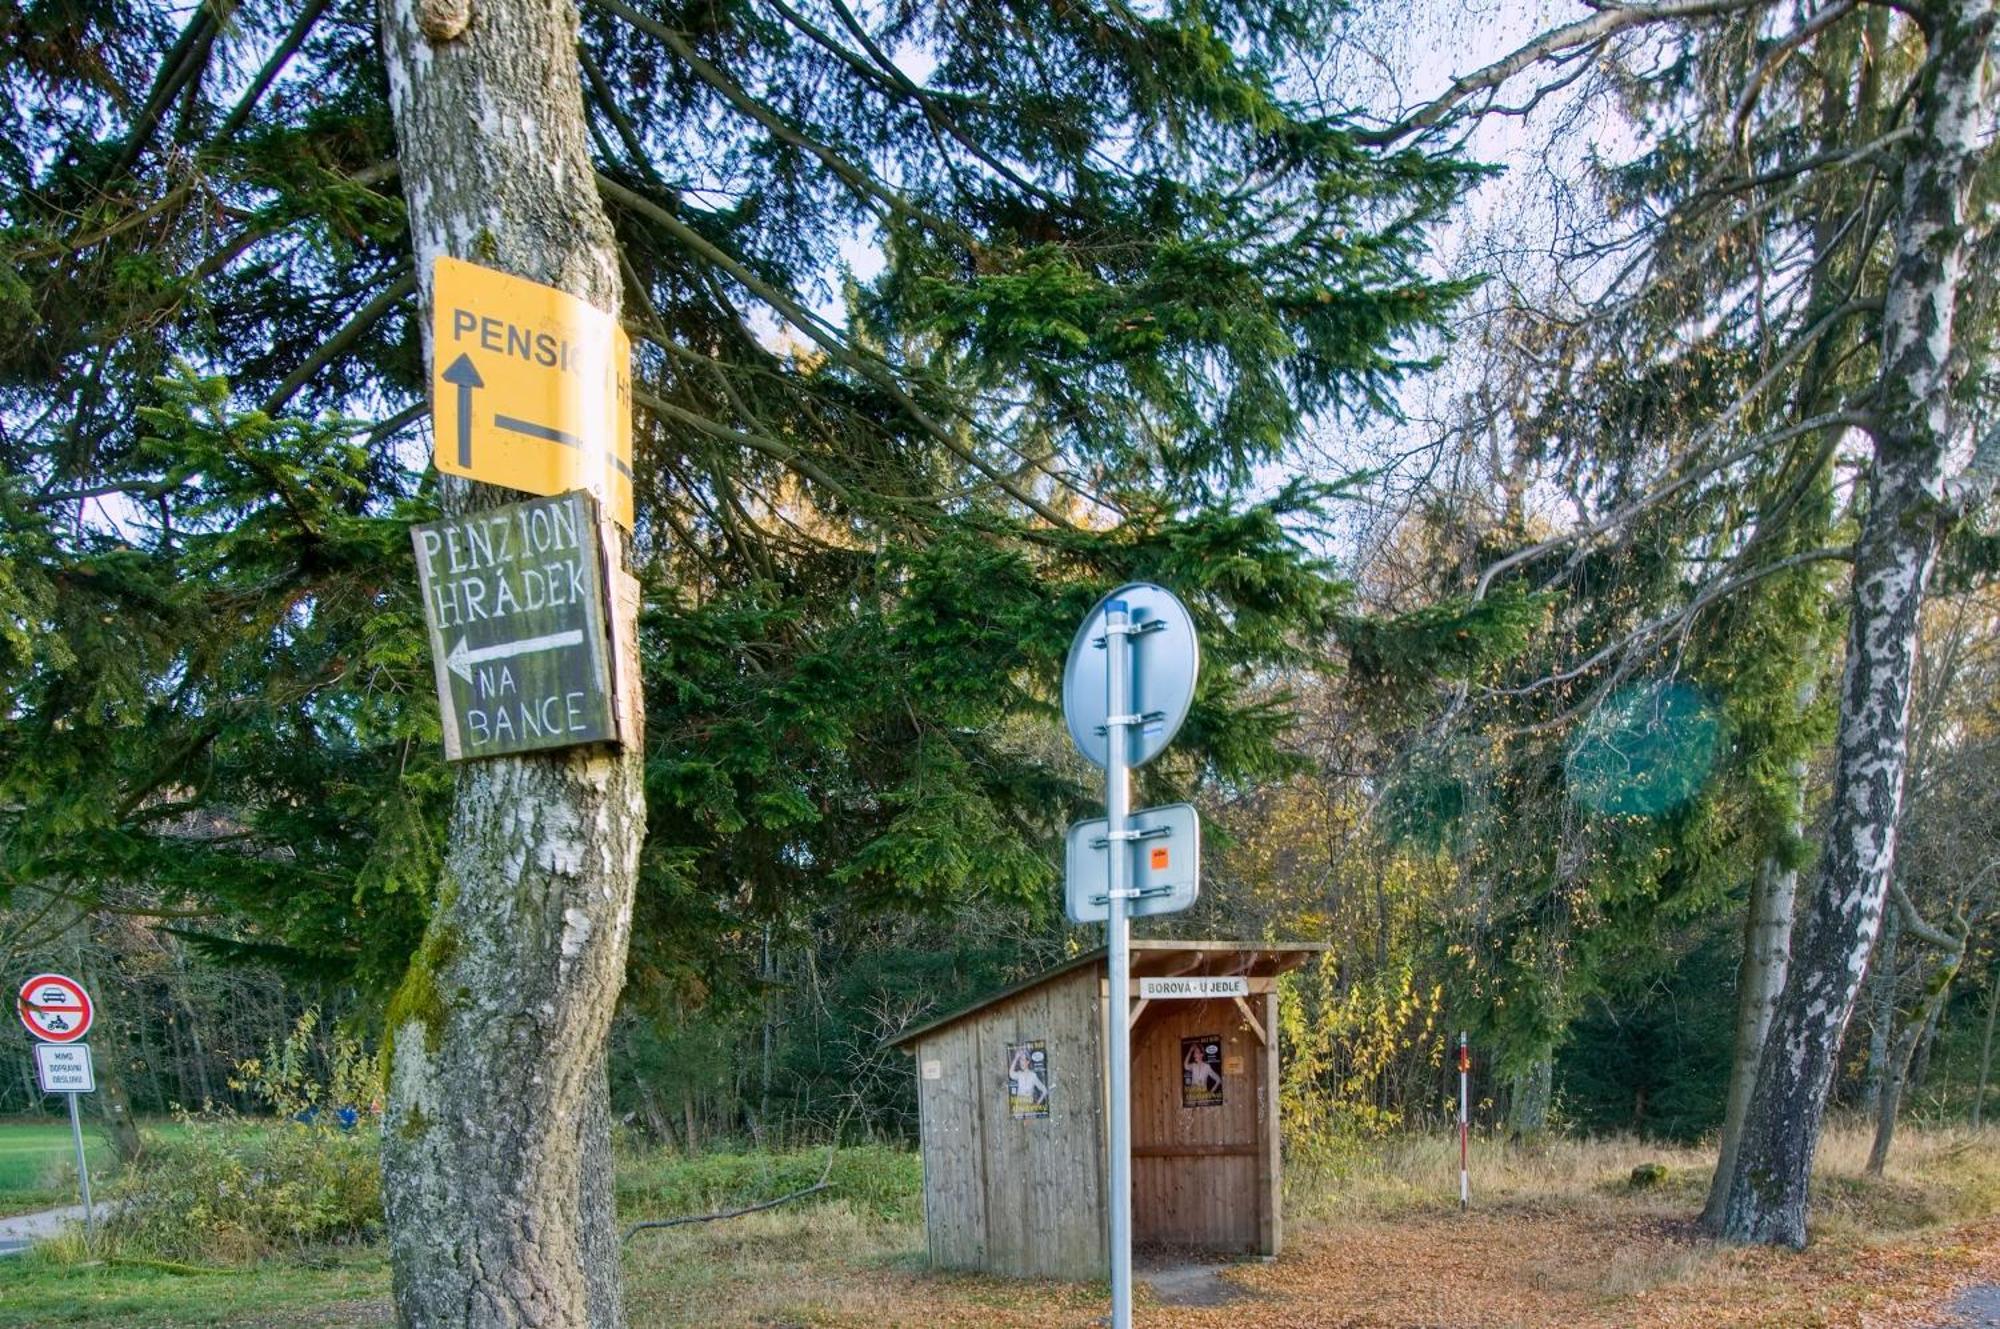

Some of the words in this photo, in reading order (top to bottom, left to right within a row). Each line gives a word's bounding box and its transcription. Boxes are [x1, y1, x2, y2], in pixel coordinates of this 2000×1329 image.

[420, 499, 580, 577] PENZION
[433, 560, 585, 629] HRÁDEK
[479, 665, 517, 700] NA
[468, 692, 587, 746] BANCE
[1200, 982, 1208, 993] U
[1210, 981, 1240, 993] JEDLE
